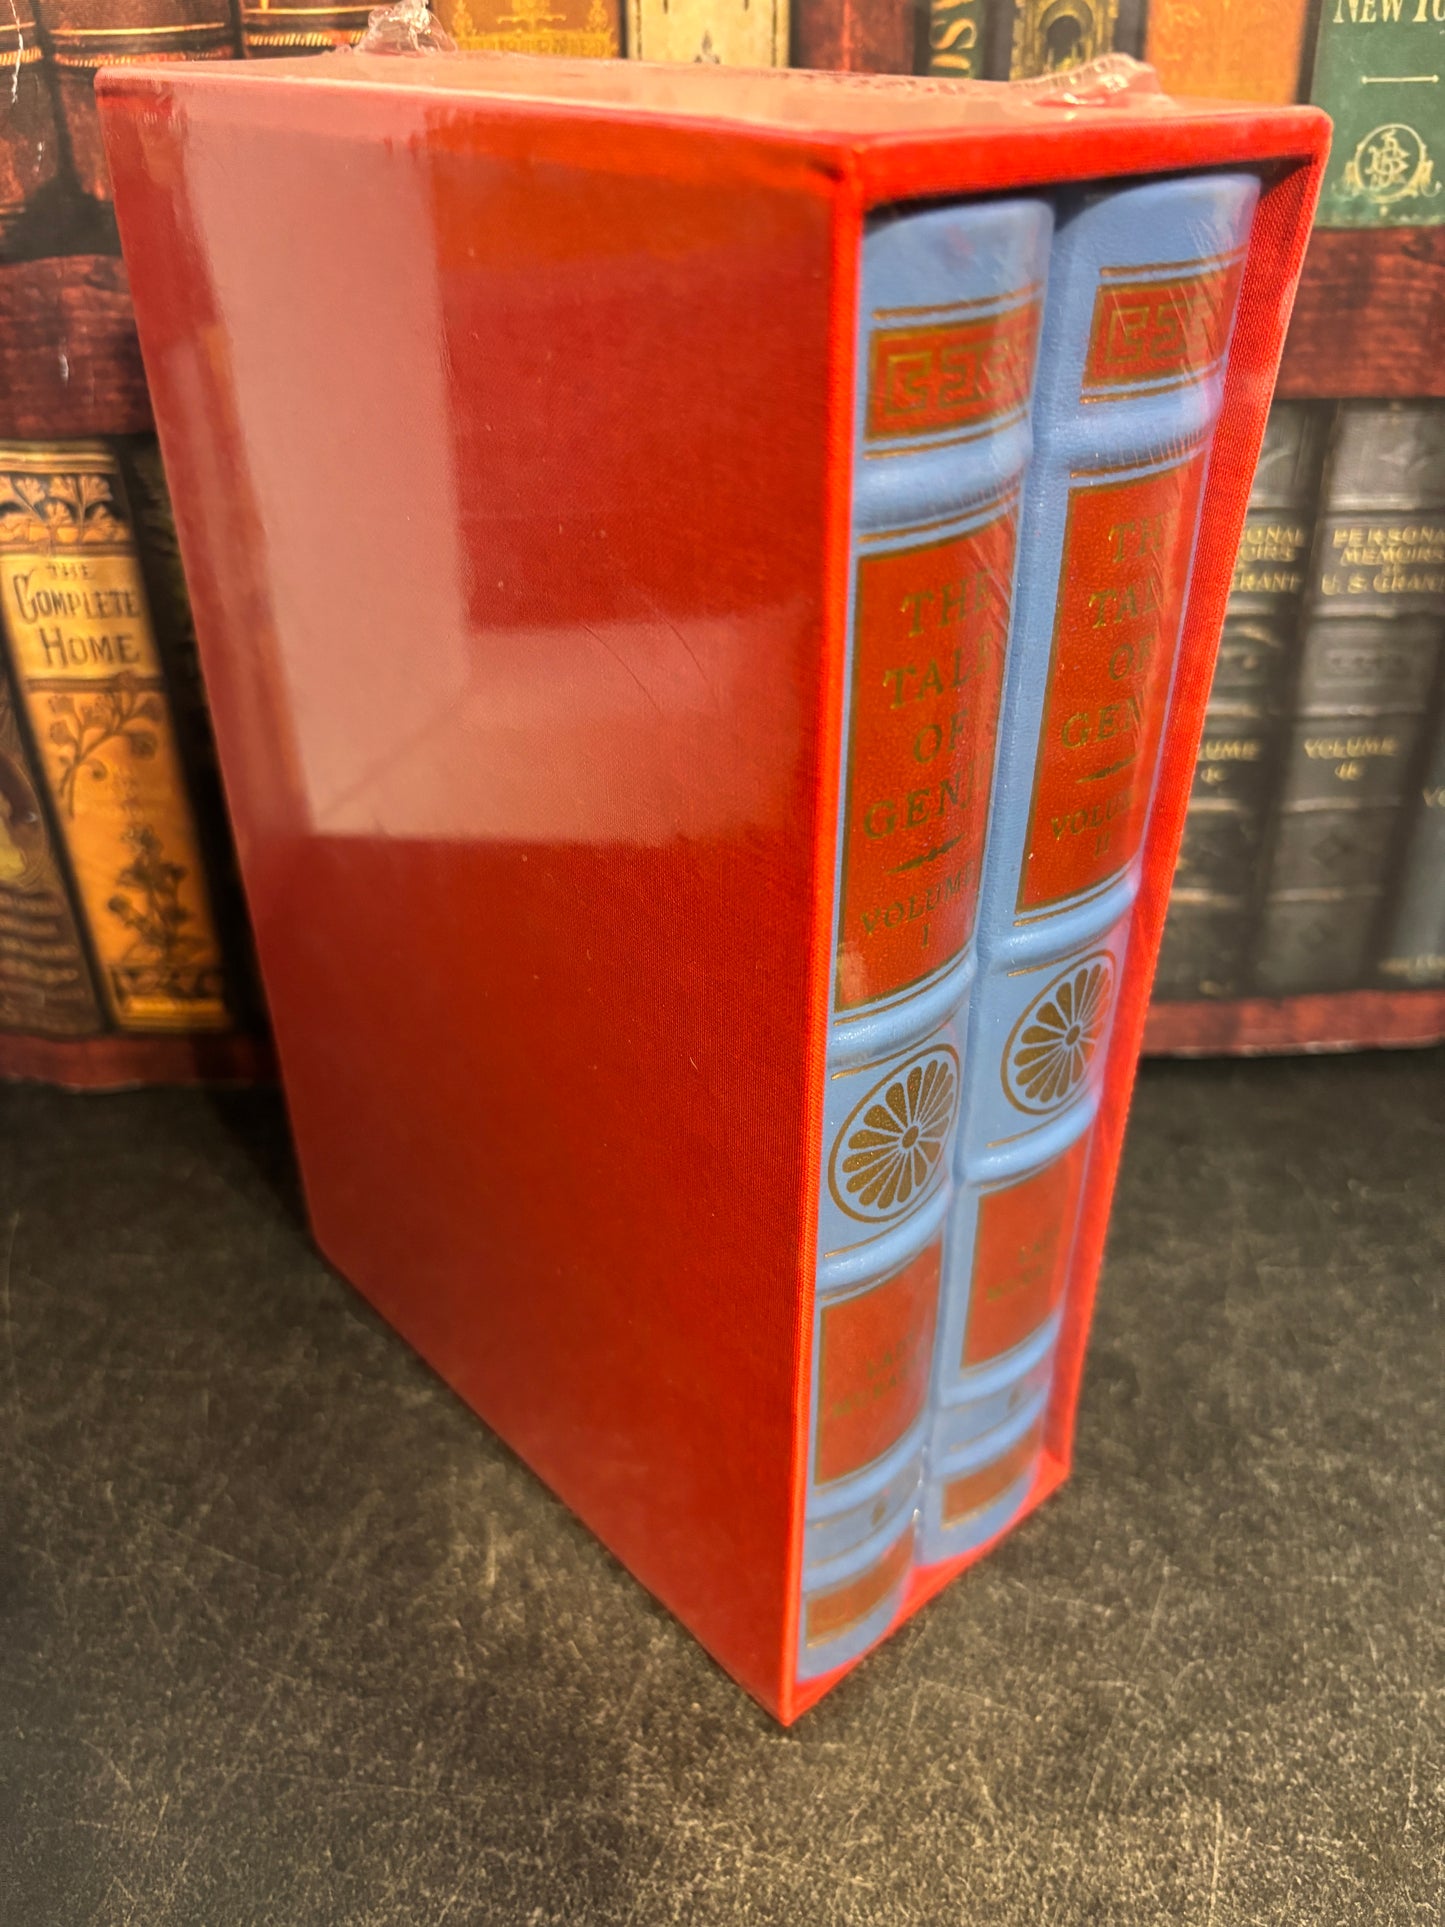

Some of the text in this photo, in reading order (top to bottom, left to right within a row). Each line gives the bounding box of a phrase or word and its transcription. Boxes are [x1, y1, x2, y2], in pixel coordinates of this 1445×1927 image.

[1108, 512, 1165, 563] TH
[13, 568, 141, 625] COMPLETE
[1088, 574, 1163, 629] TAL
[39, 627, 141, 670] HOME
[913, 709, 969, 763] OF
[1061, 692, 1144, 749] GEN
[920, 923, 931, 948] I
